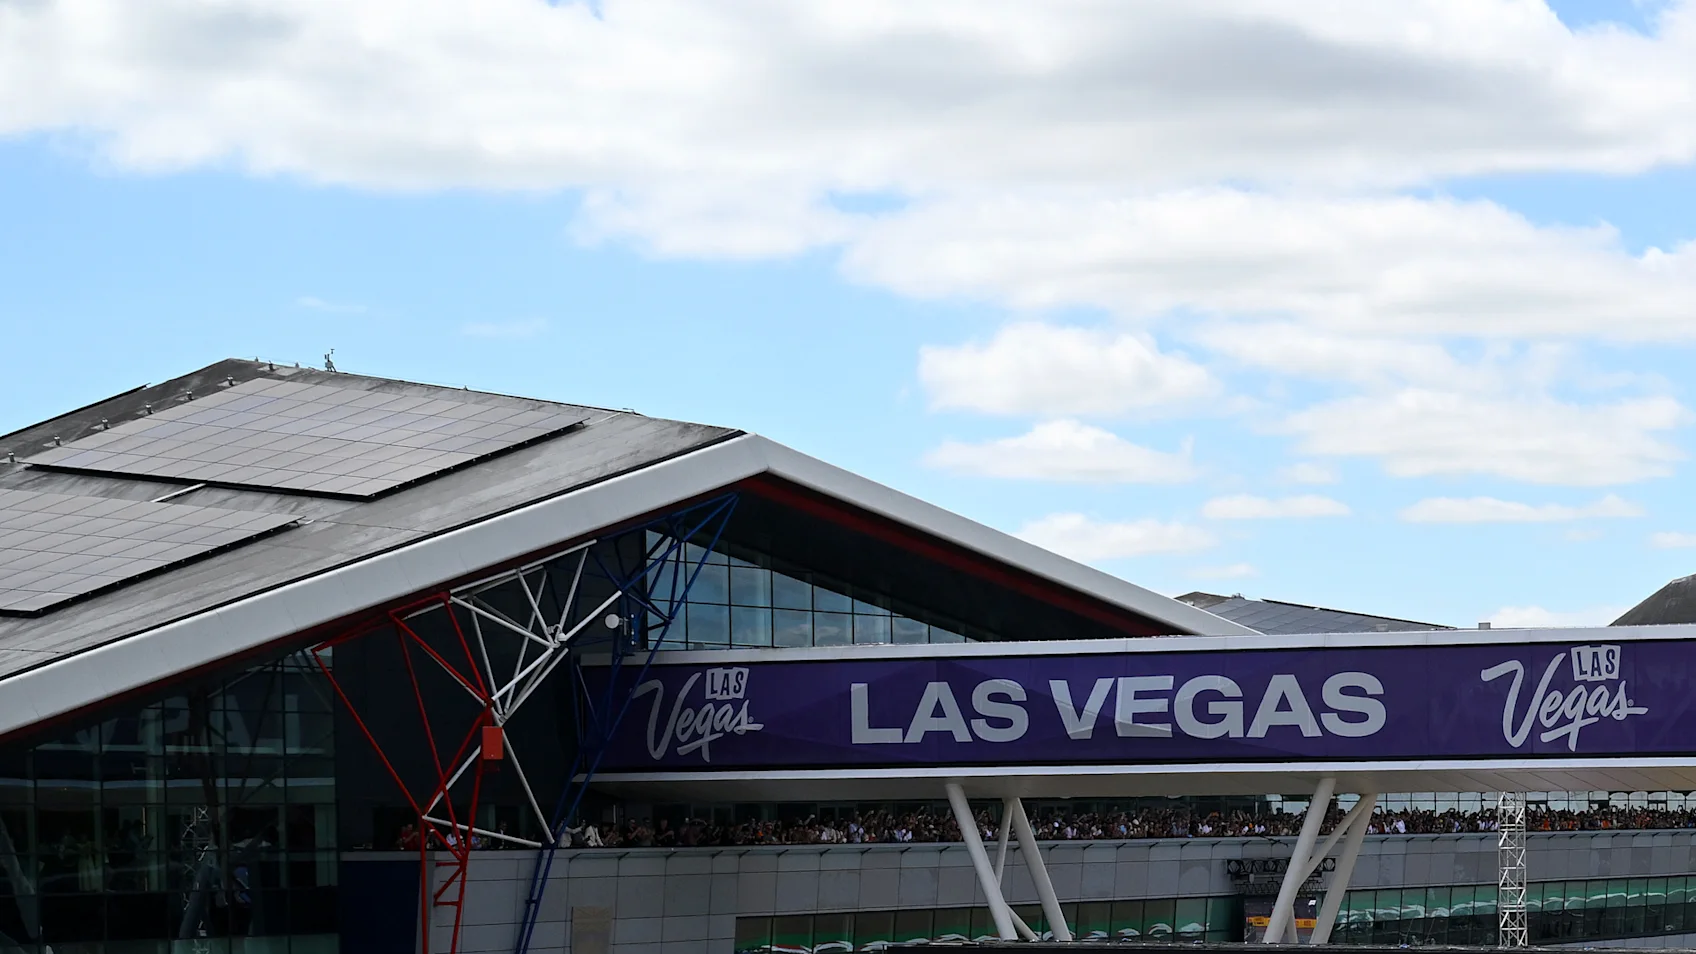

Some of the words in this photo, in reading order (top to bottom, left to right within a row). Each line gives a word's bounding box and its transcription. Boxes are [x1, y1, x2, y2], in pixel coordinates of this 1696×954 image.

[709, 670, 746, 699] LAS
[1574, 646, 1618, 680] LAS
[633, 673, 764, 762] Vegas
[850, 678, 1029, 744] LAS
[1048, 671, 1387, 739] VEGAS
[1480, 654, 1648, 751] Vegas
